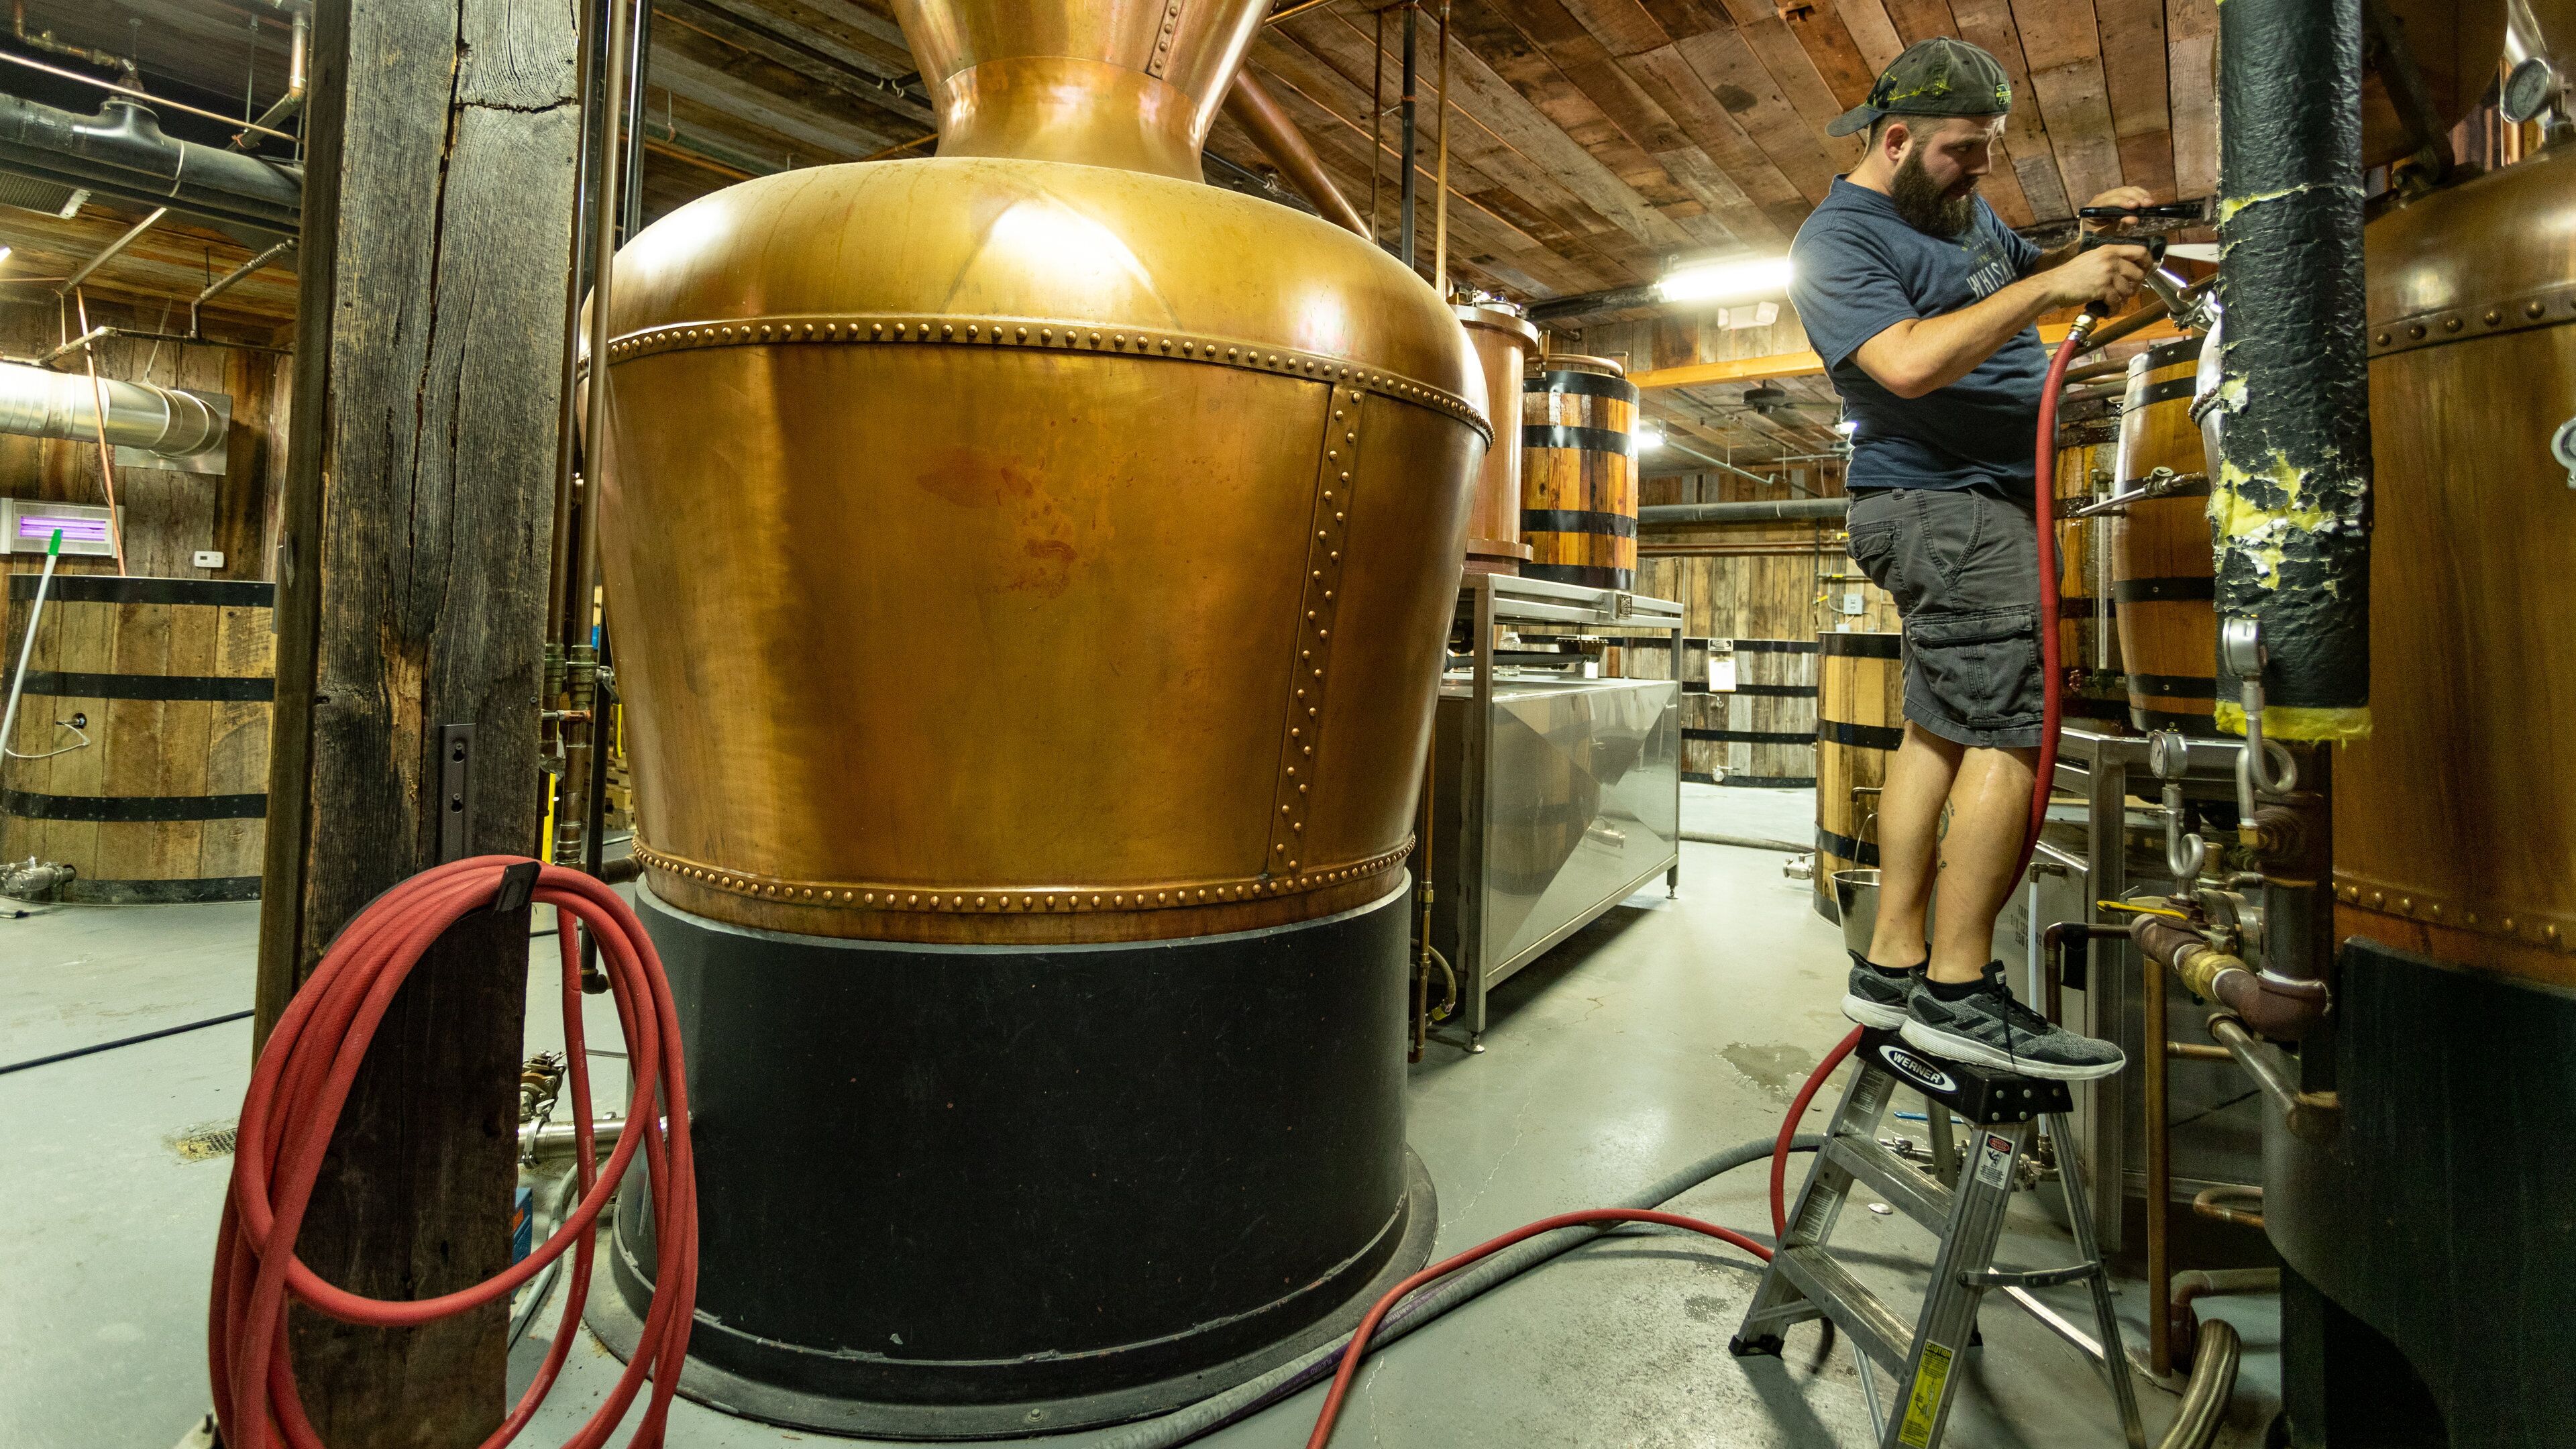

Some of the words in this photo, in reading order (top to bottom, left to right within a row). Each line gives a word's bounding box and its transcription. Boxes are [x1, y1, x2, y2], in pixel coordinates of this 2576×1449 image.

[1893, 1051, 1941, 1083] WERNER
[1384, 1303, 1412, 1324] GOODYEAR
[1926, 1342, 1952, 1358] CAUTION
[1309, 1356, 1333, 1375] PLICORD
